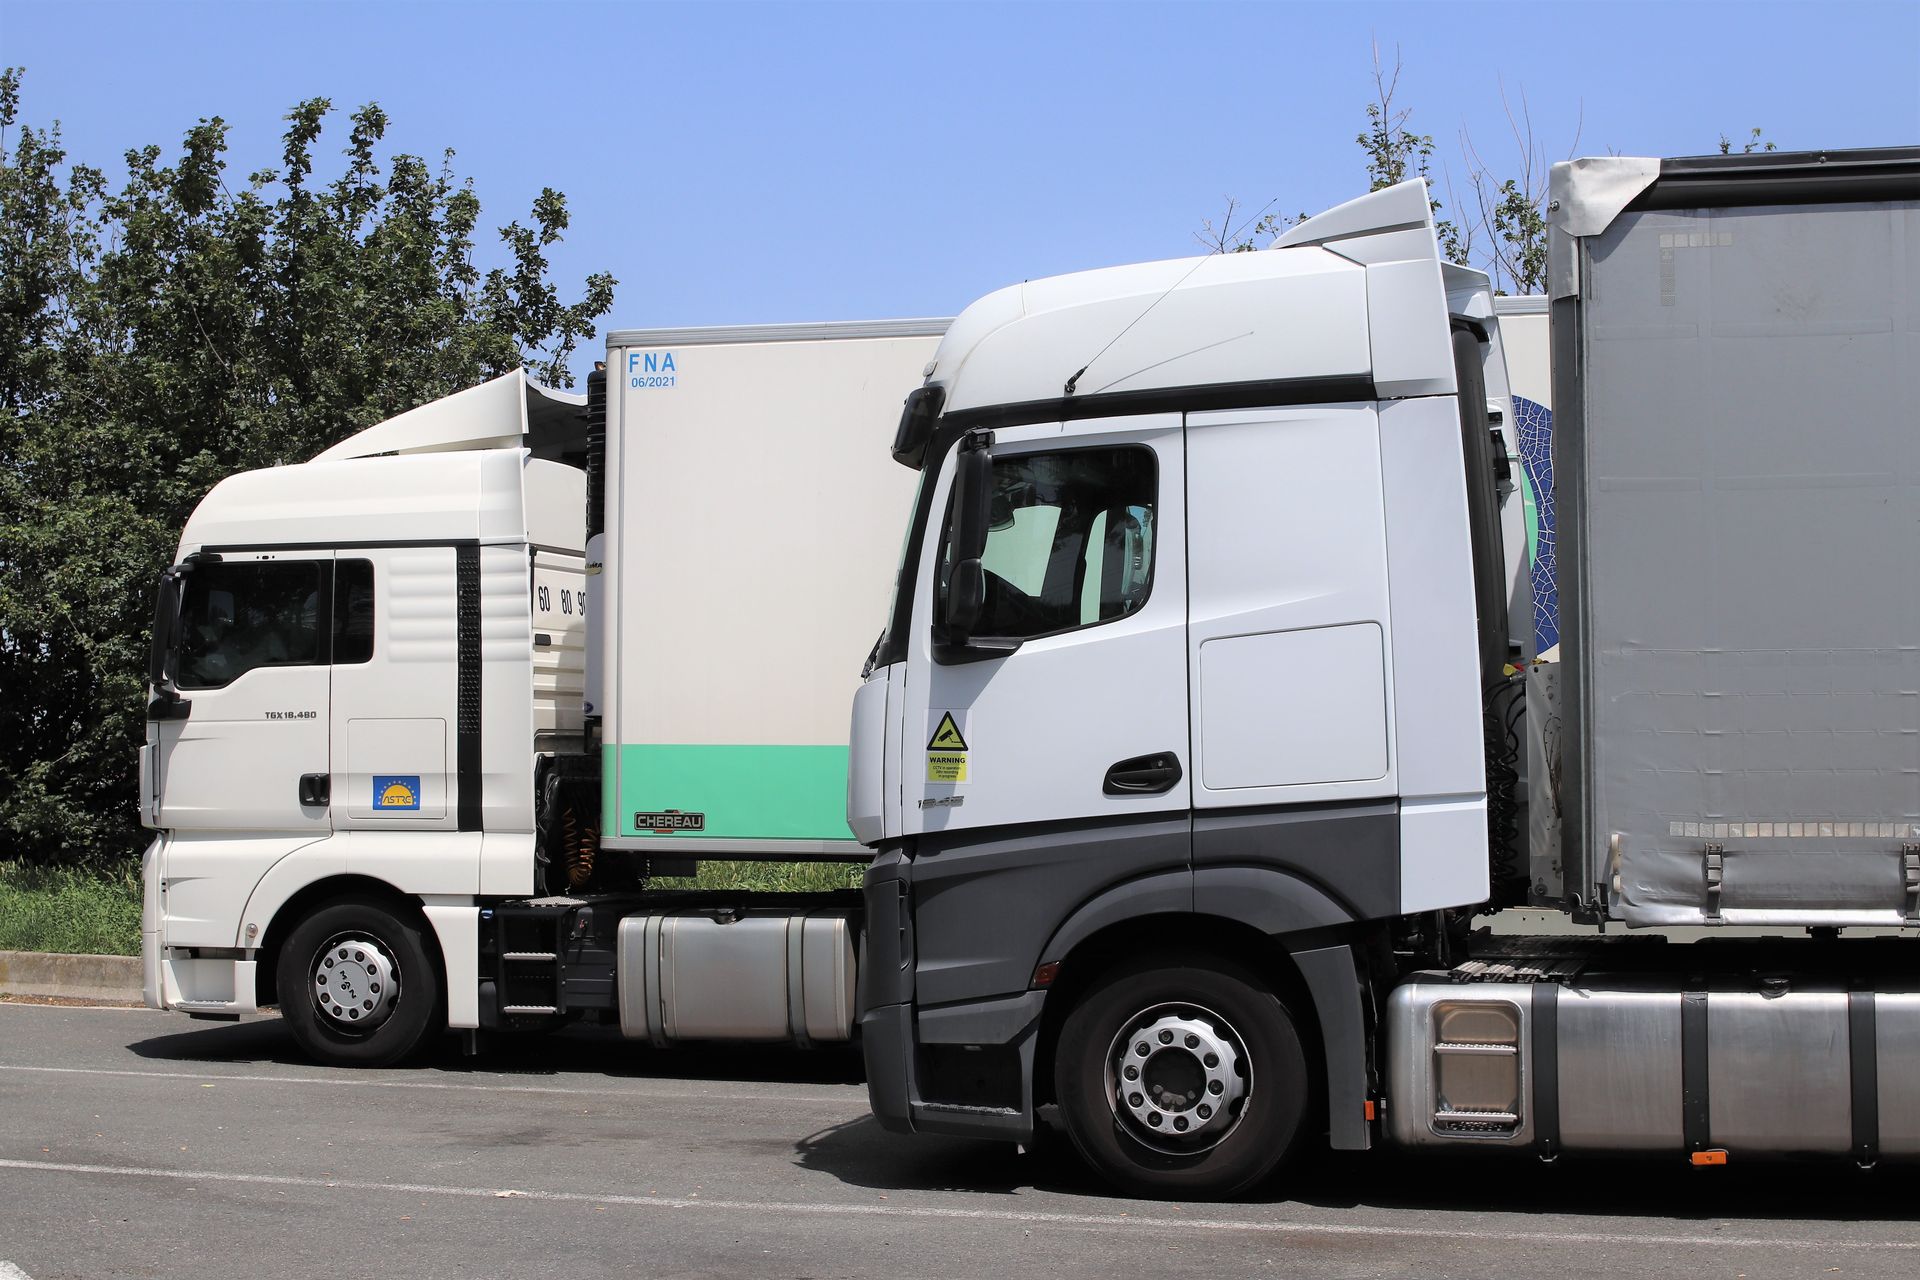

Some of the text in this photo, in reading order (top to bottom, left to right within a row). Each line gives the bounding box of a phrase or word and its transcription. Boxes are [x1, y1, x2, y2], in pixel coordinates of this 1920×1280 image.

[629, 352, 676, 373] FNA
[631, 376, 675, 388] 06/2021
[538, 585, 551, 612] 60
[561, 589, 573, 615] 80
[637, 815, 702, 828] CHEREAU
[340, 970, 358, 999] MAN
